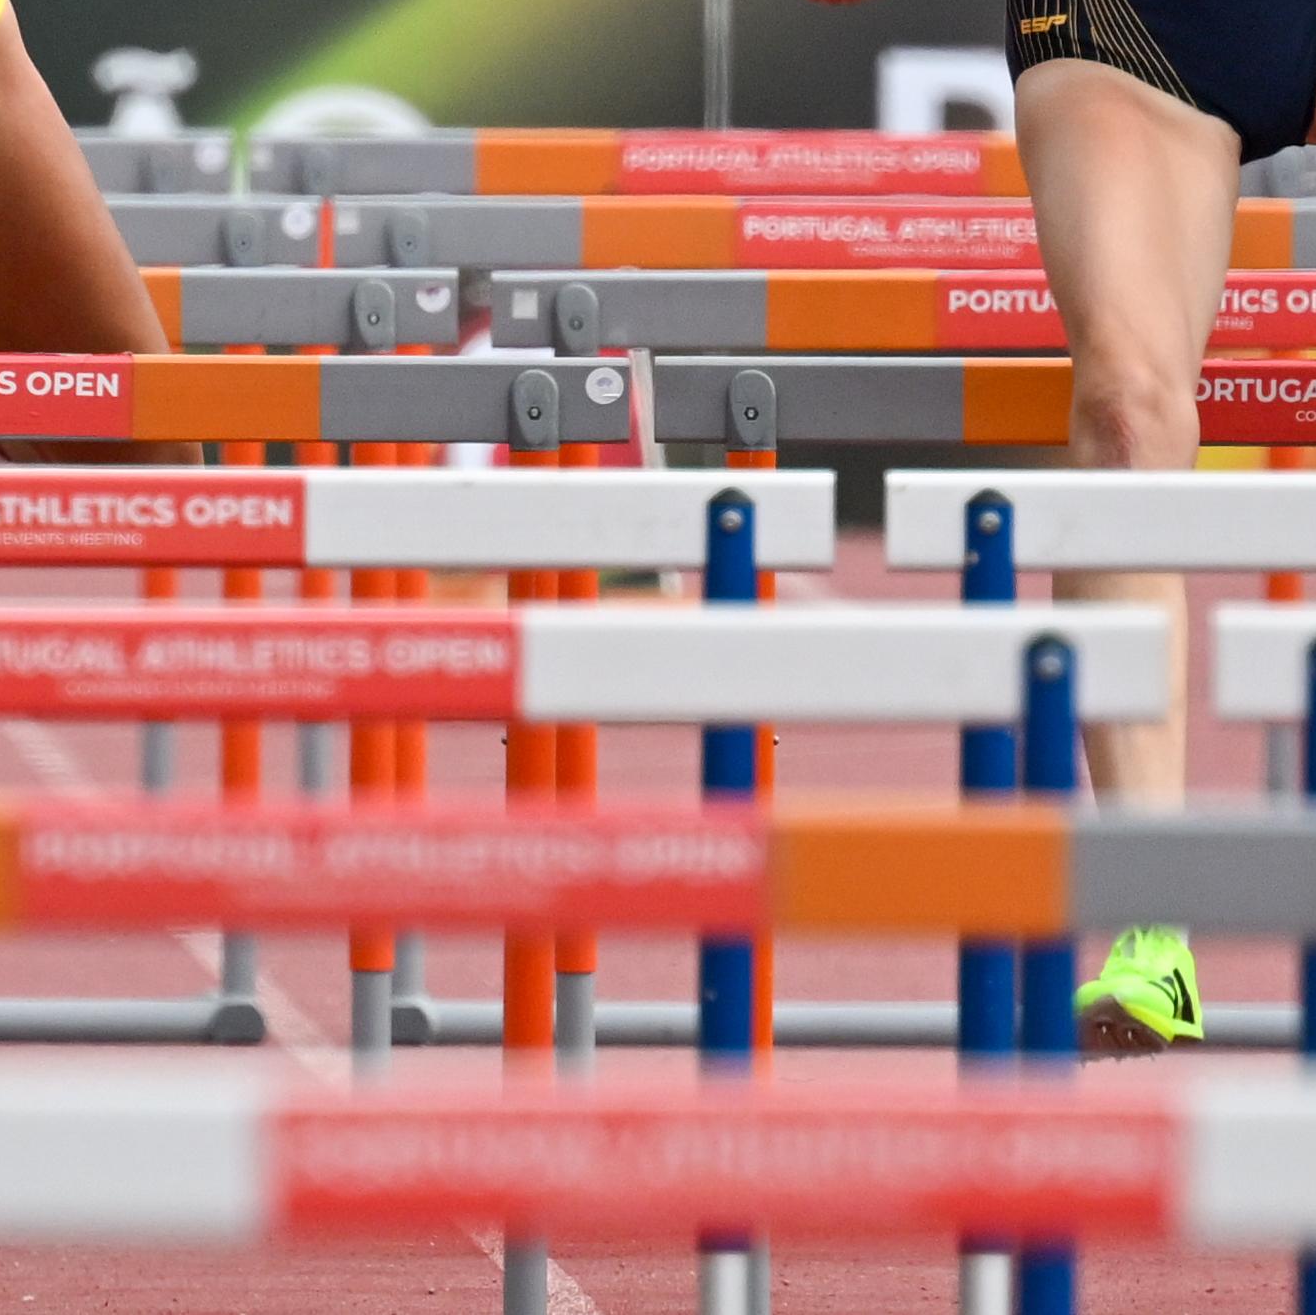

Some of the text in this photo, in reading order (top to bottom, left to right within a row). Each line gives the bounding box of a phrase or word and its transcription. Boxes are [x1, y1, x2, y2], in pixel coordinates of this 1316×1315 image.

[1020, 14, 1068, 35] ESP
[743, 216, 891, 242] PORTUGAL
[948, 289, 1058, 314] PORTU
[26, 370, 120, 398] OPEN
[185, 496, 293, 528] OPEN
[2, 532, 65, 546] EVENTS
[69, 532, 143, 547] MEETING
[136, 637, 372, 674] ATHLETICS
[382, 637, 506, 673] OPEN
